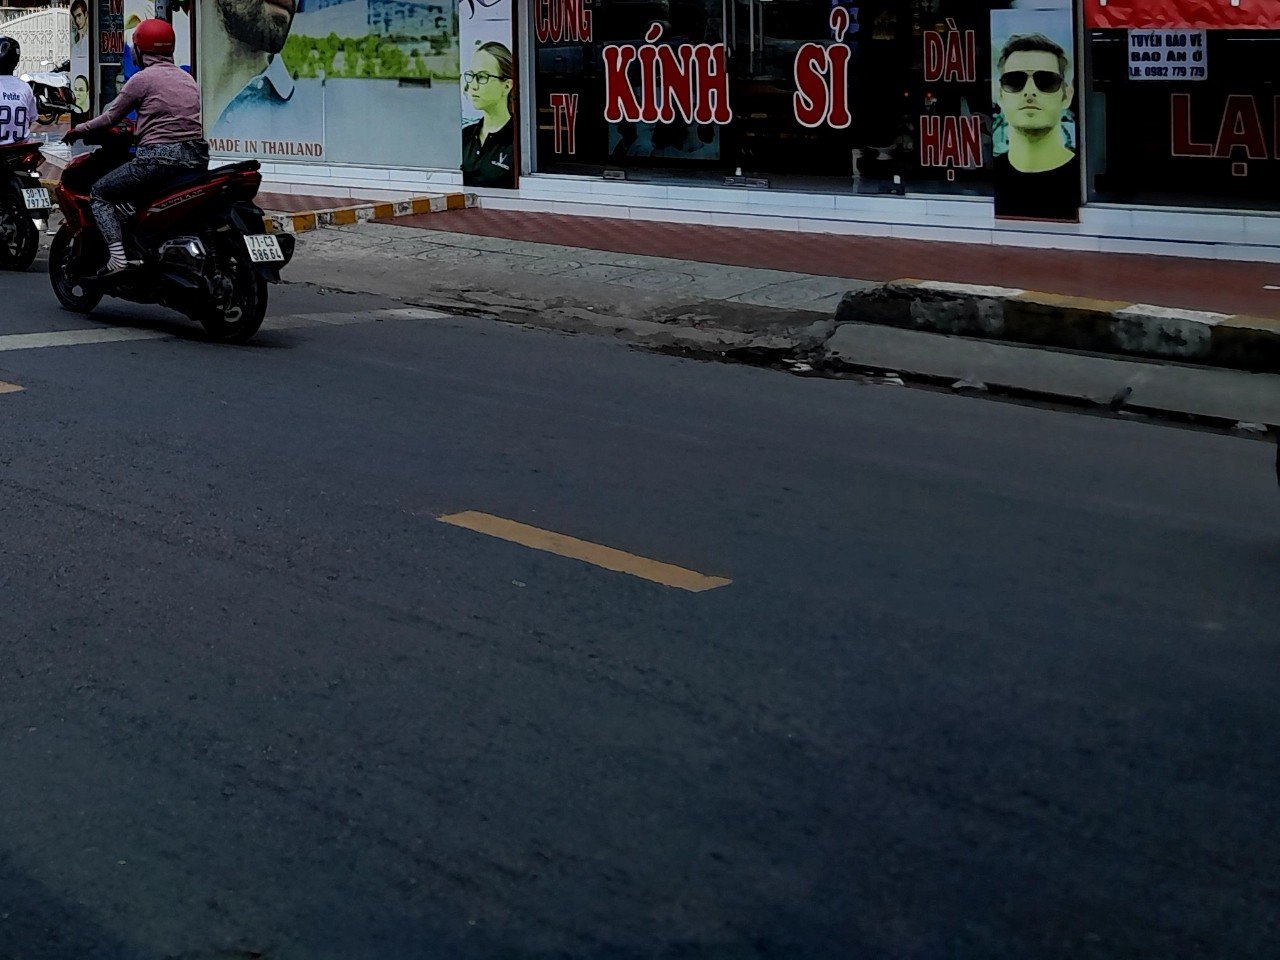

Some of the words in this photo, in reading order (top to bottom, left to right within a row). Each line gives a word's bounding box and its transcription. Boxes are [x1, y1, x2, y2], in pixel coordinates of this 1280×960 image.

[602, 22, 732, 125] KÍNH
[792, 7, 853, 130] SỈ
[923, 17, 977, 83] DÀI
[208, 138, 240, 152] MADE
[245, 140, 258, 153] IN
[261, 141, 323, 156] THAILAND
[549, 93, 578, 155] TY
[920, 115, 983, 182] HẠN
